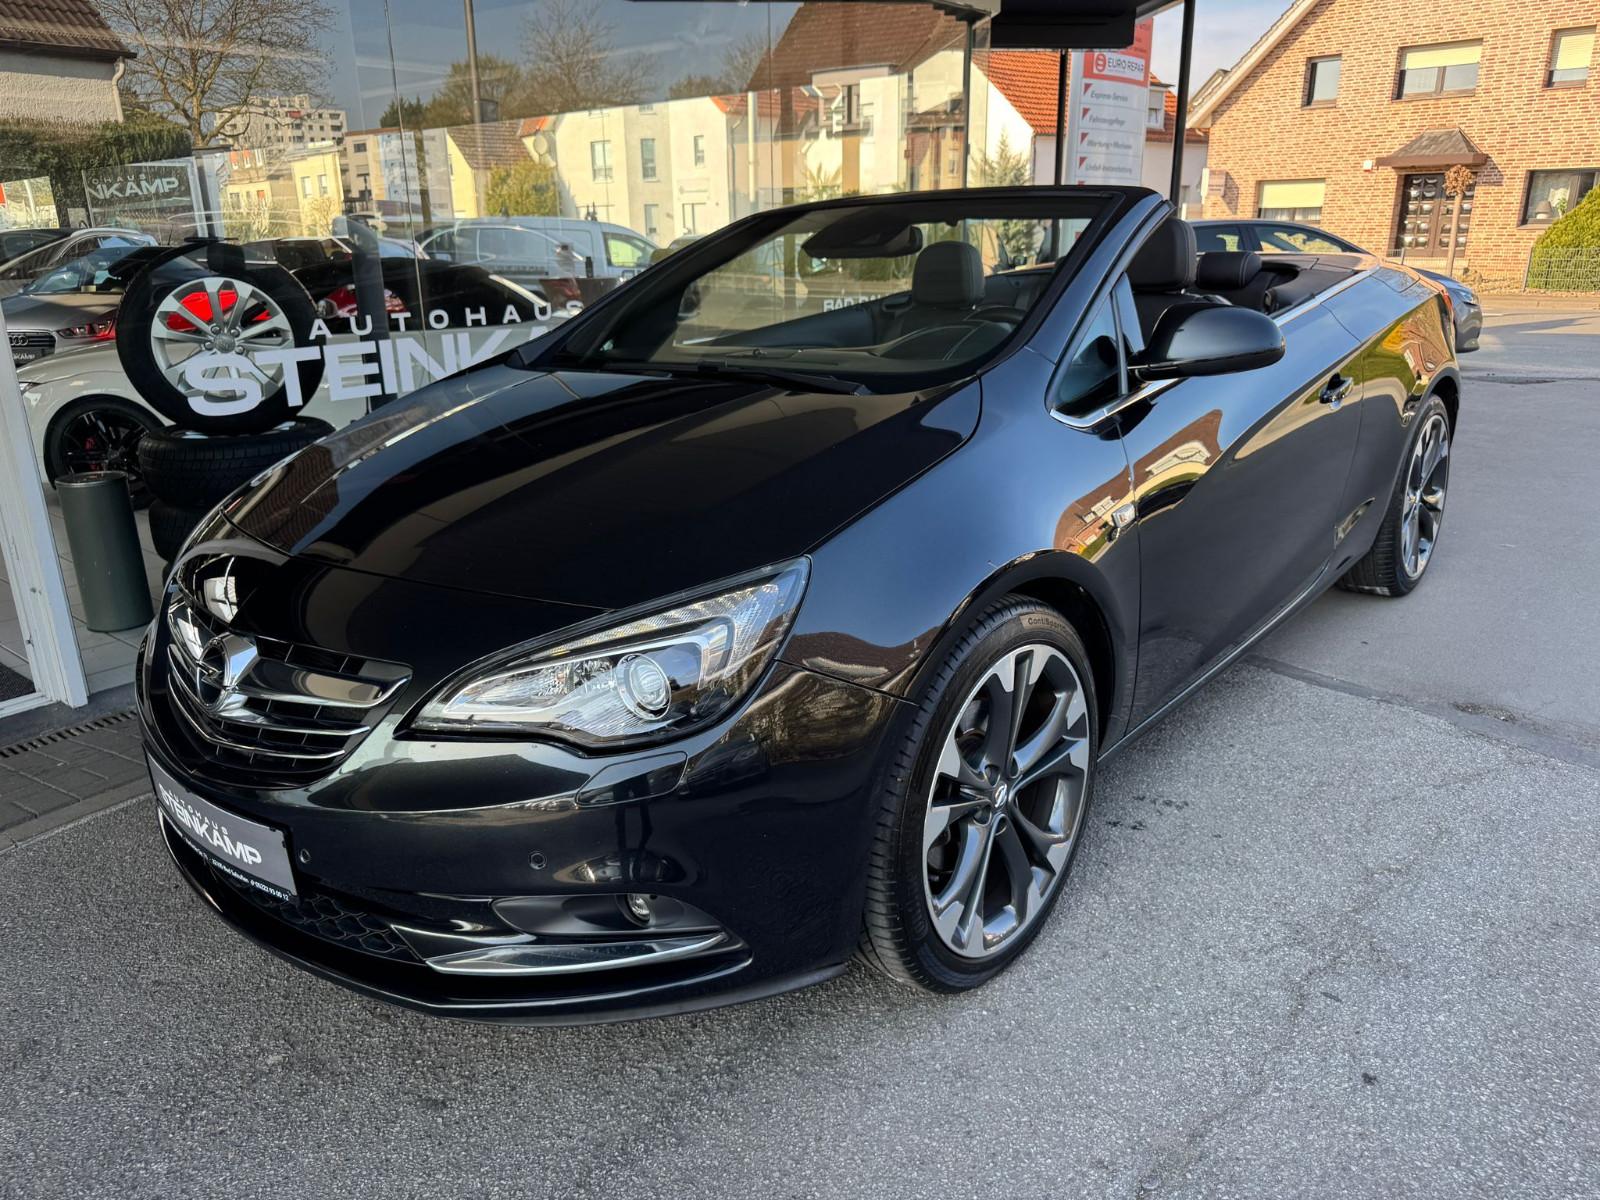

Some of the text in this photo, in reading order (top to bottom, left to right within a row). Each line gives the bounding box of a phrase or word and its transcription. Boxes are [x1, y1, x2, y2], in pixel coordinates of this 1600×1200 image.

[1107, 57, 1126, 69] EURO
[308, 299, 584, 341] AUTOHAUS
[183, 325, 554, 417] STEINK
